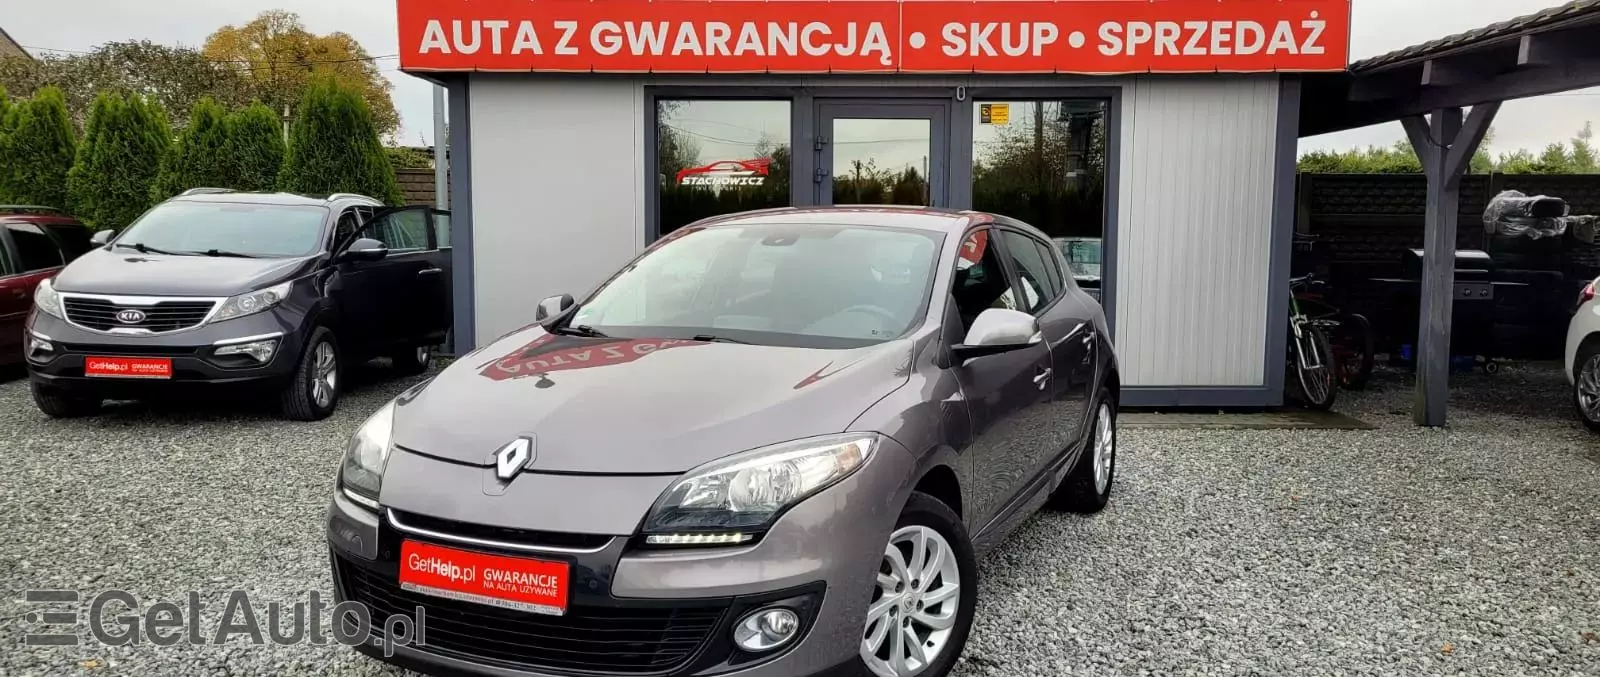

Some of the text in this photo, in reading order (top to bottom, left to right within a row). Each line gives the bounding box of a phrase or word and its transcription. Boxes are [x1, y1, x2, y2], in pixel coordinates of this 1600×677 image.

[418, 10, 1327, 66] AUTA Z GWARANCJĄ SKUP SPRZEDAŻ
[681, 176, 765, 186] STACHOWICZ
[120, 312, 141, 320] KIA
[408, 553, 476, 584] GetHelp.pl
[483, 567, 558, 589] GWARANCJE
[483, 581, 495, 590] NA
[496, 582, 517, 593] AUTA
